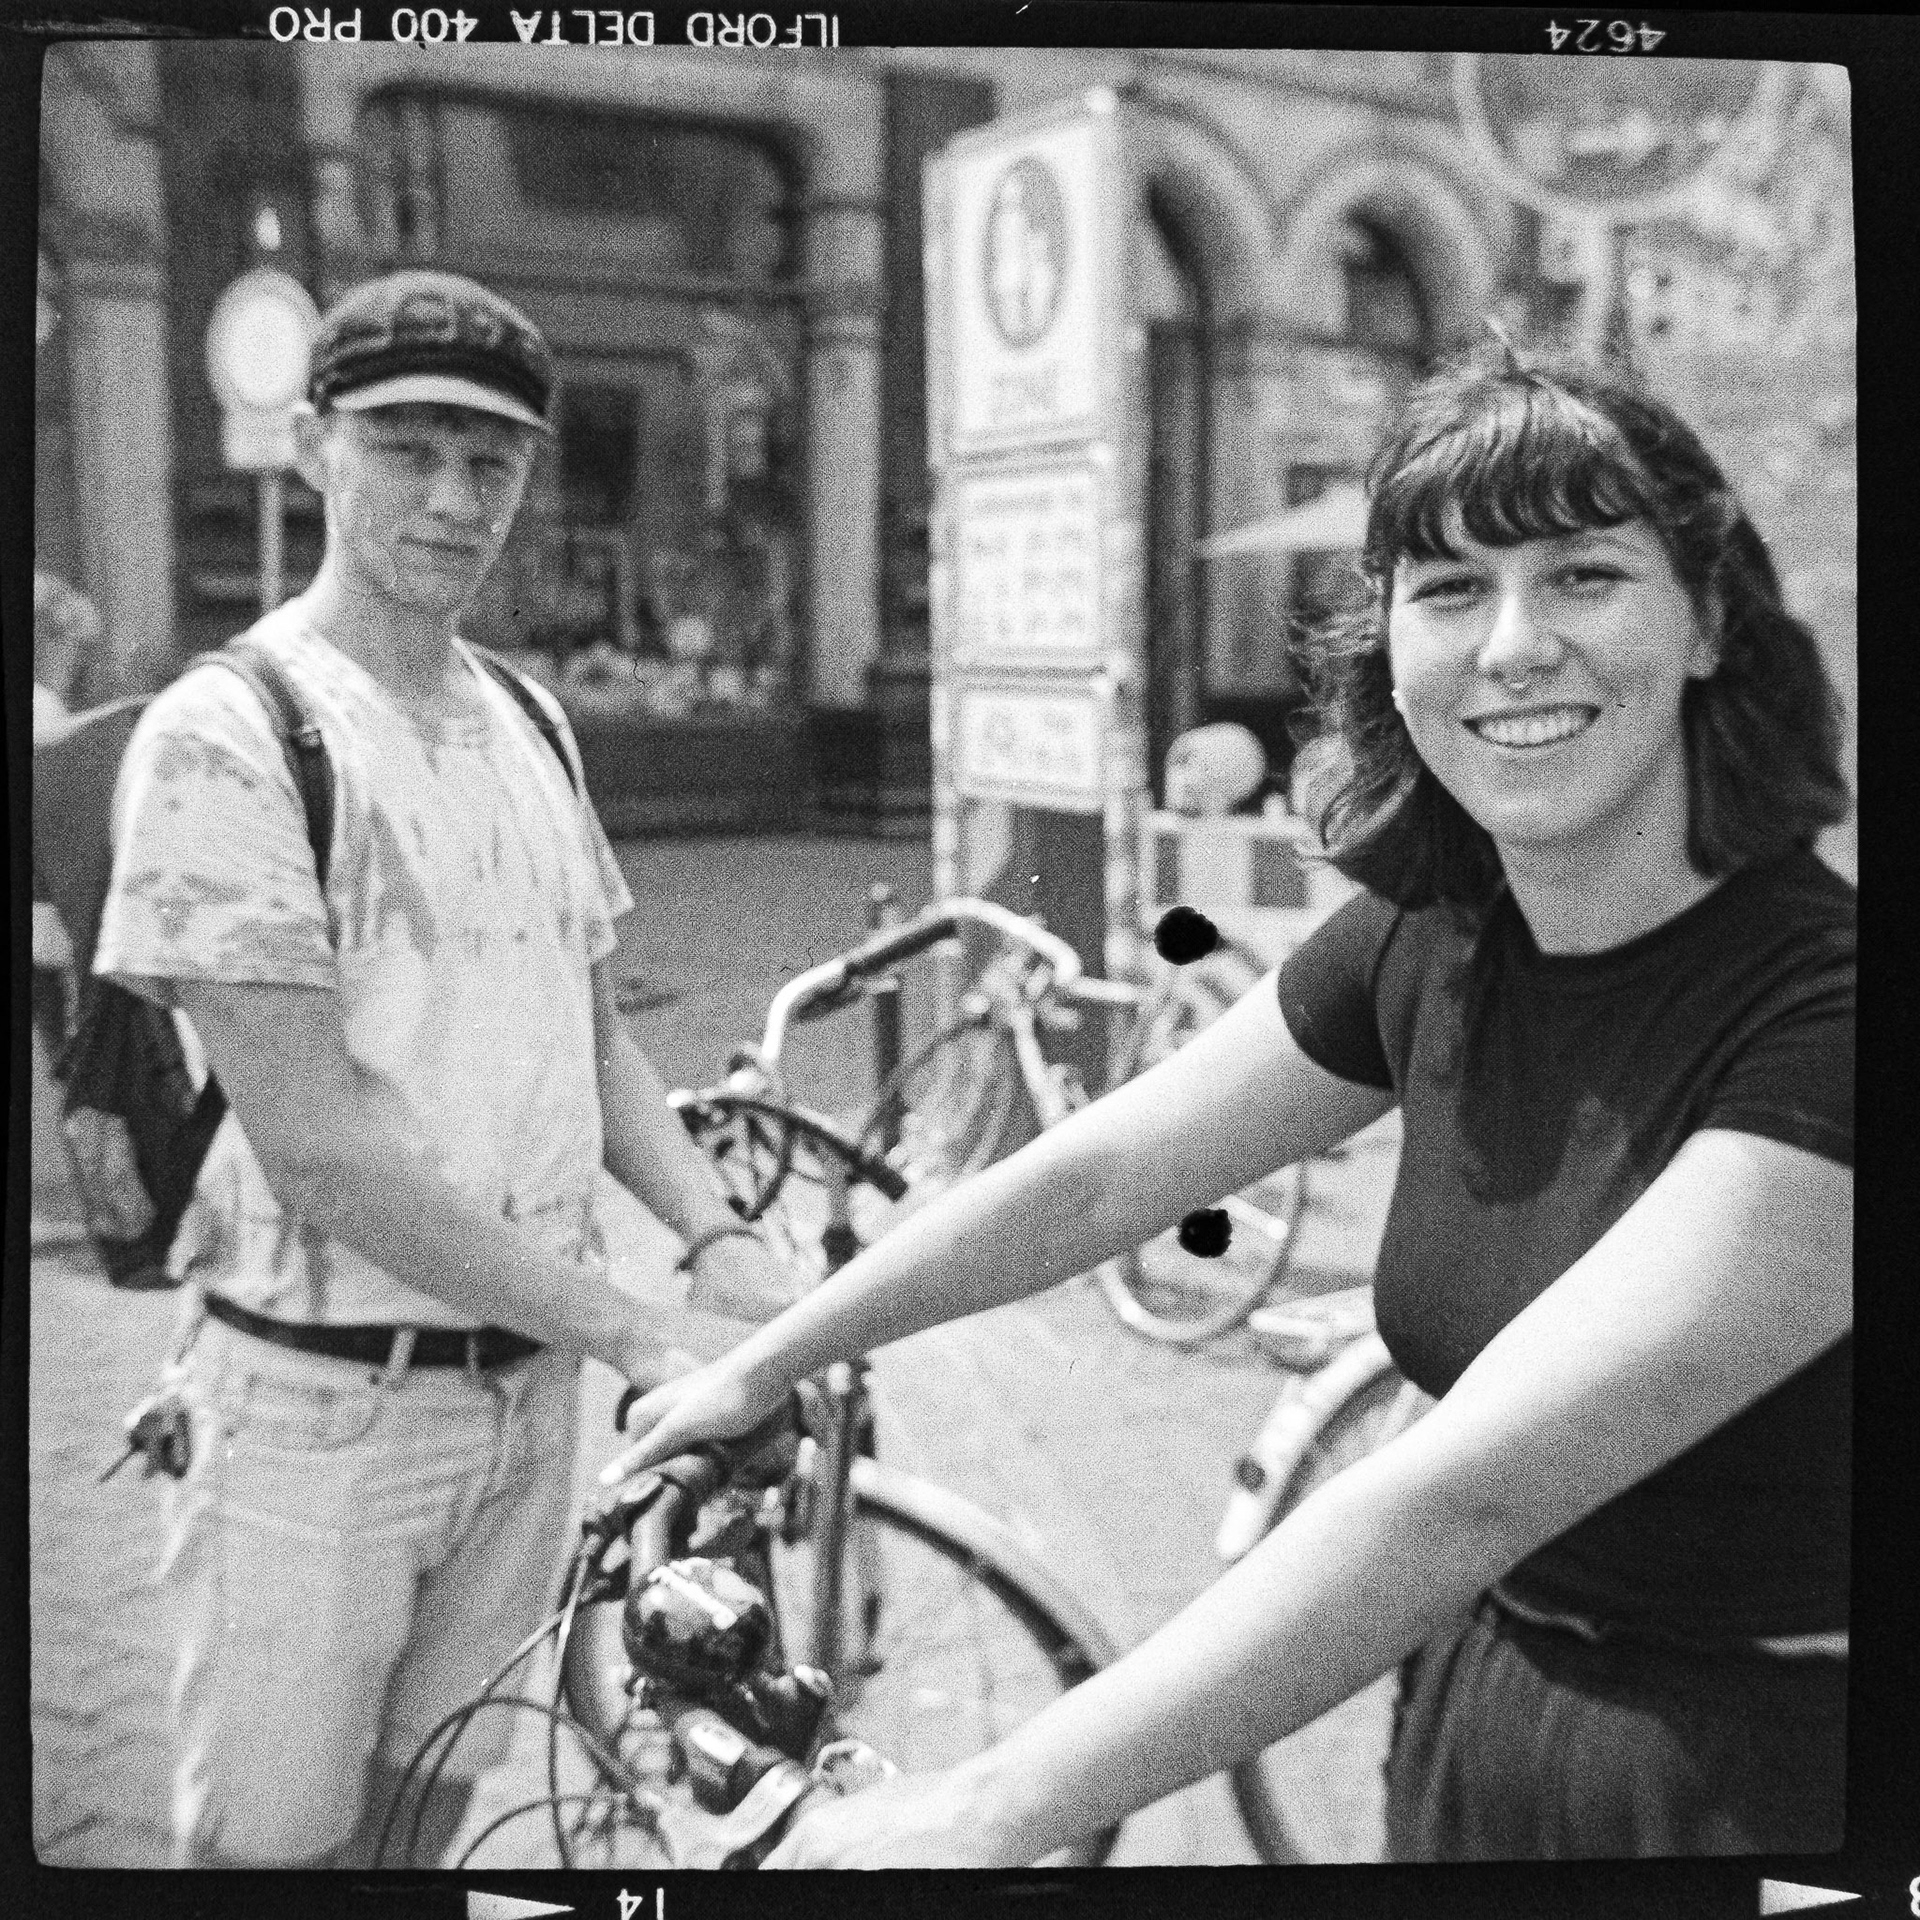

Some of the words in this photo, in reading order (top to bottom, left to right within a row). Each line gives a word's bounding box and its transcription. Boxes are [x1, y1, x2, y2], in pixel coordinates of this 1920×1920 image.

[269, 6, 361, 43] PRO
[392, 8, 478, 43] 400
[510, 9, 654, 47] DELTA
[687, 13, 839, 49] ILFORD
[1545, 19, 1666, 52] 4624
[616, 1887, 665, 1920] 14
